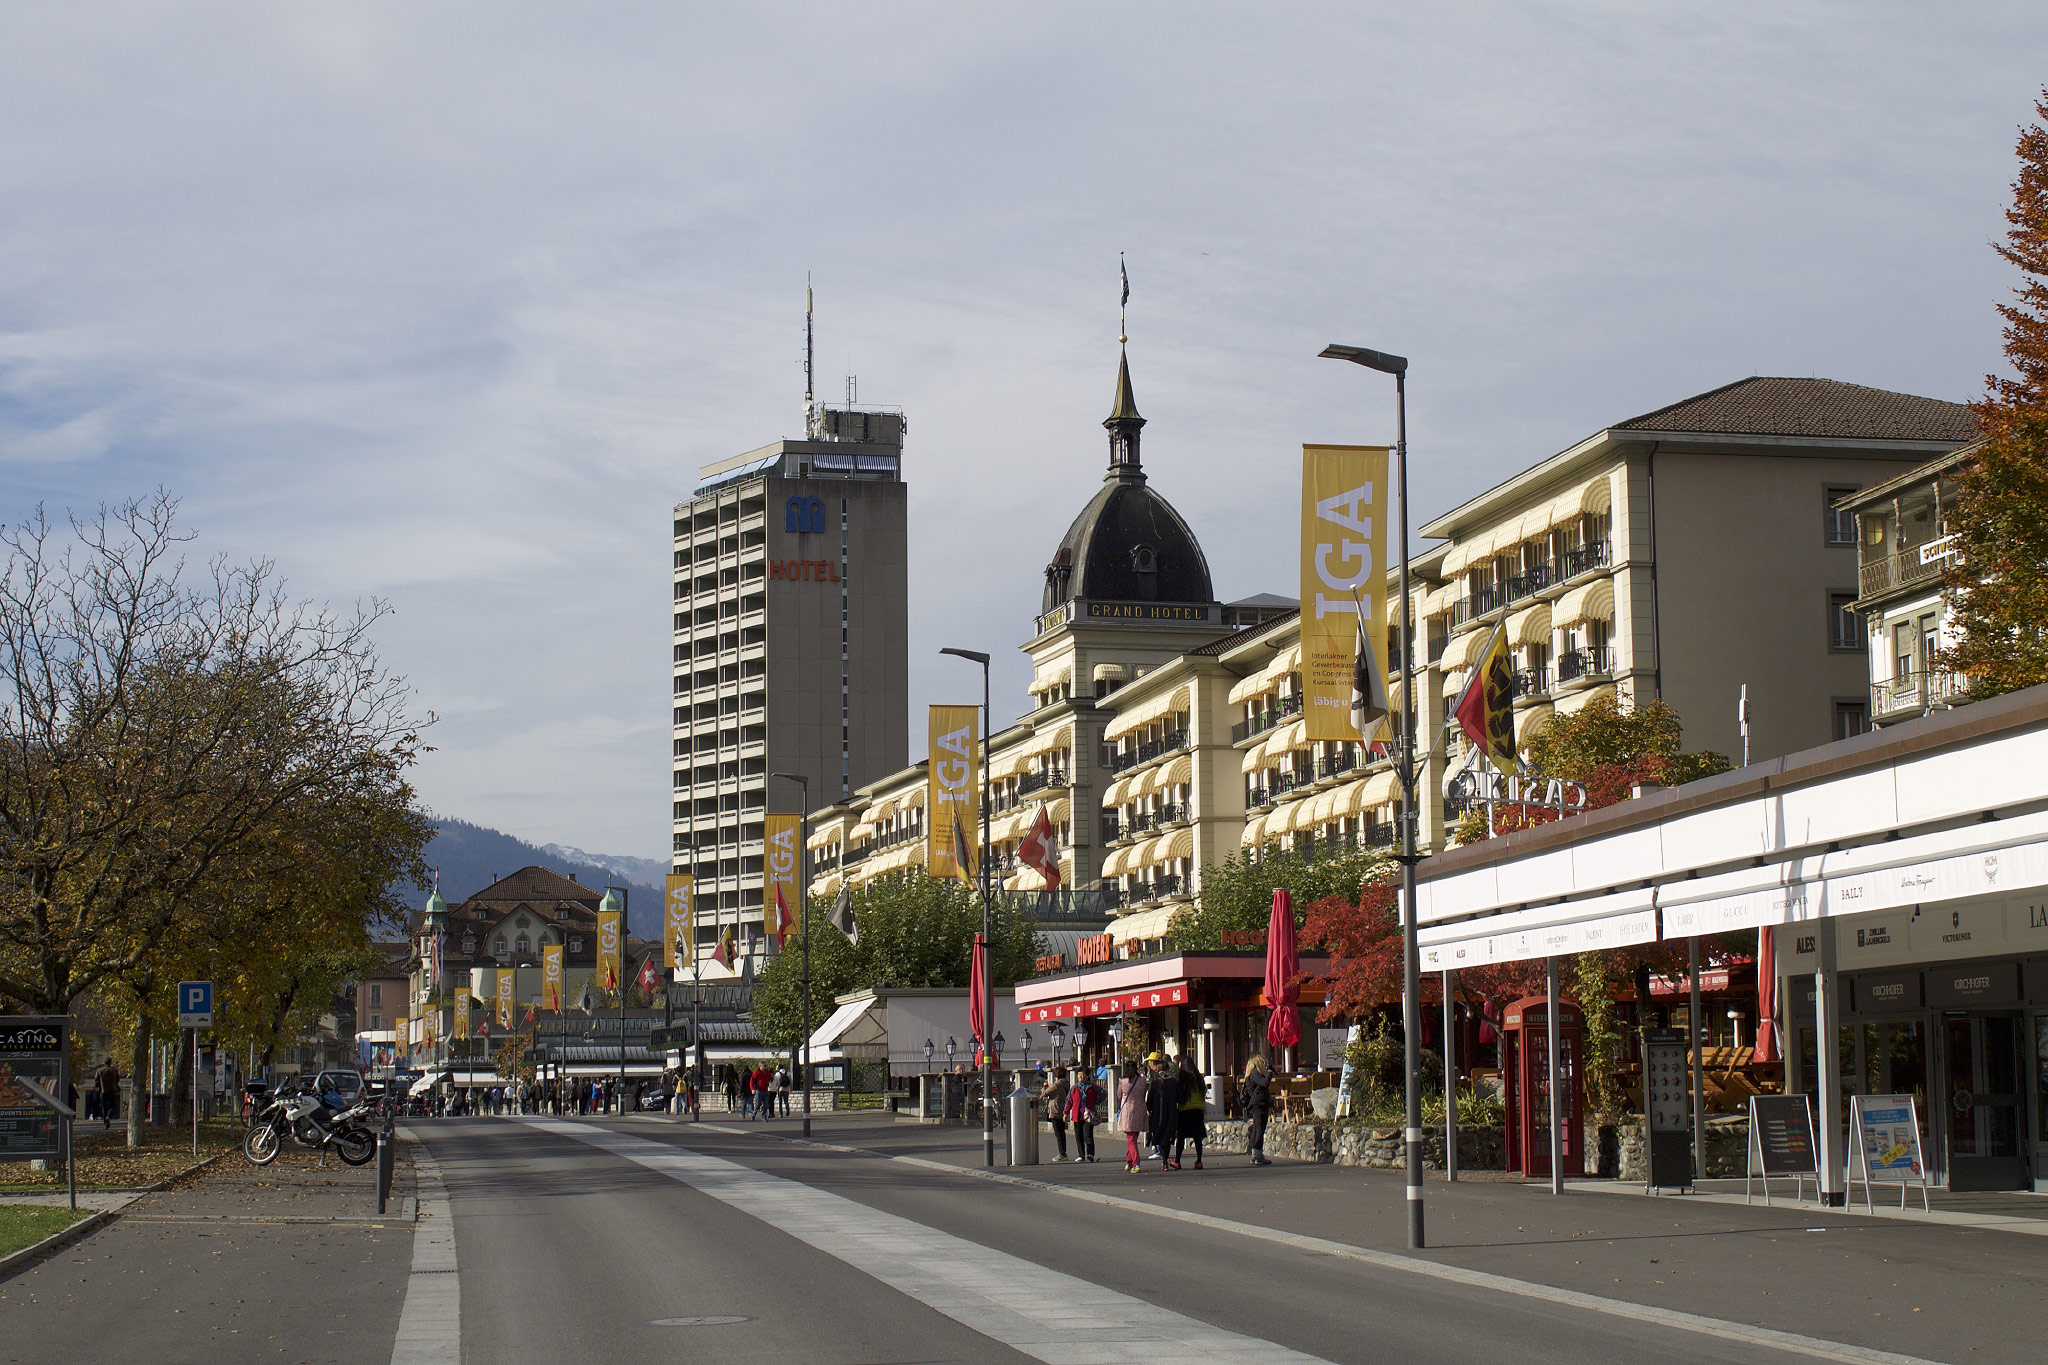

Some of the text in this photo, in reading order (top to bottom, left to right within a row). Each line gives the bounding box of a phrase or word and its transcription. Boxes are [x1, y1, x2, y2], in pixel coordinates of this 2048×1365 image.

[1314, 481, 1373, 620] IGA
[1923, 538, 1956, 560] SCHWE
[769, 559, 841, 582] HOTEL
[1092, 604, 1202, 620] GRAND HOTEL
[1311, 652, 1348, 660] Interlakner
[1311, 661, 1355, 669] Gewerbeauss
[1322, 670, 1352, 679] Congress
[1313, 696, 1340, 708] läbig
[937, 725, 970, 806] IGA
[769, 827, 794, 885] IGA
[670, 884, 690, 928] IGA
[1723, 906, 1747, 918] GUCCI
[2029, 904, 2048, 928] LA
[602, 919, 617, 956] IGA
[1077, 933, 1113, 966] HOOTERS
[546, 951, 561, 983] IGA
[500, 974, 512, 1001] IGA
[1872, 984, 1904, 996] KIRCHHOFER
[1954, 976, 1990, 990] KIRCHHOFER
[189, 989, 204, 1010] P
[457, 992, 468, 1016] IGA
[425, 1008, 435, 1030] IGA
[0, 1034, 54, 1044] CASINO
[397, 1021, 407, 1041] IGA
